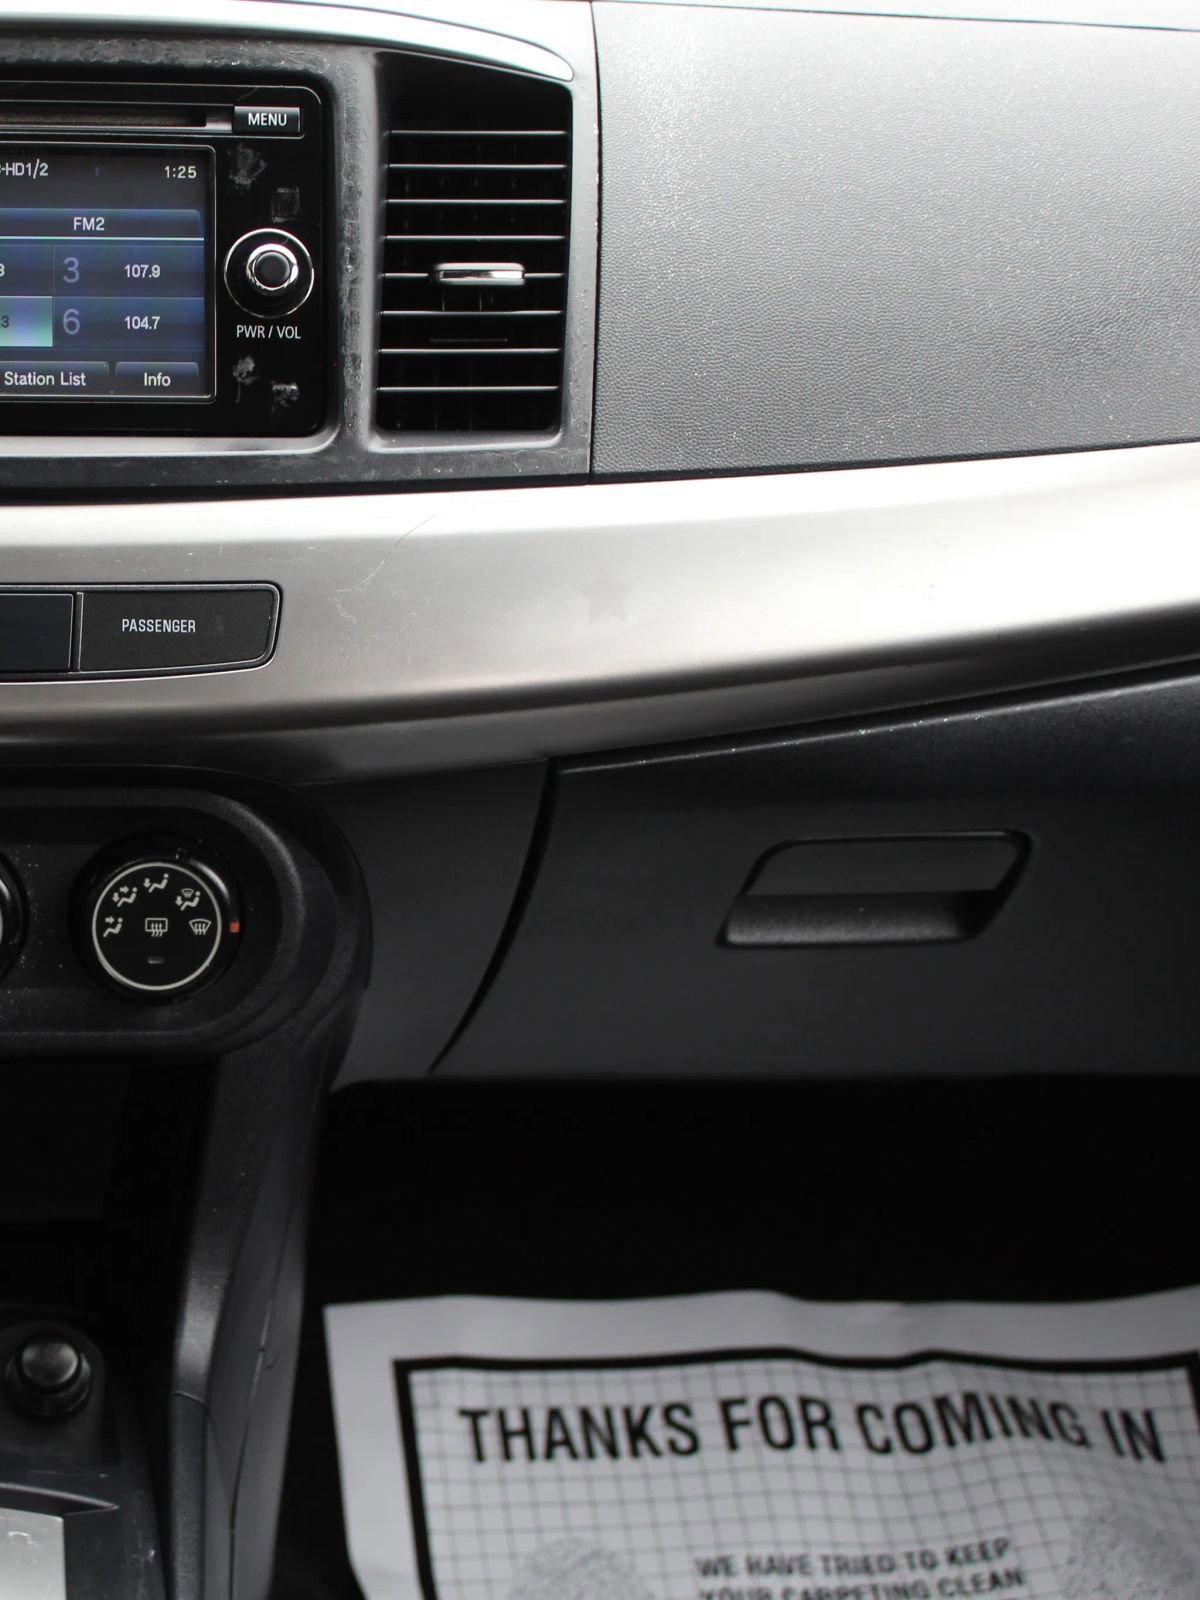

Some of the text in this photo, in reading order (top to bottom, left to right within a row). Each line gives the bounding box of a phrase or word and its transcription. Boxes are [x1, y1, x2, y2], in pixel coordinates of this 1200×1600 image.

[247, 112, 288, 127] MENU
[164, 165, 197, 179] 1:25
[72, 217, 105, 232] FM2
[62, 257, 161, 283] 3 107.9
[62, 309, 161, 335] 6 104.7
[236, 325, 266, 339] PWR
[276, 326, 302, 339] VOL
[3, 371, 86, 387] Station List
[143, 372, 171, 387] Info
[121, 618, 196, 633] PASSENGER
[457, 1391, 1166, 1464] THANKS FOR COMING IN
[695, 1536, 1010, 1577] WE HAVE TRIED TO KEEP
[936, 1567, 1026, 1599] CLEAN
